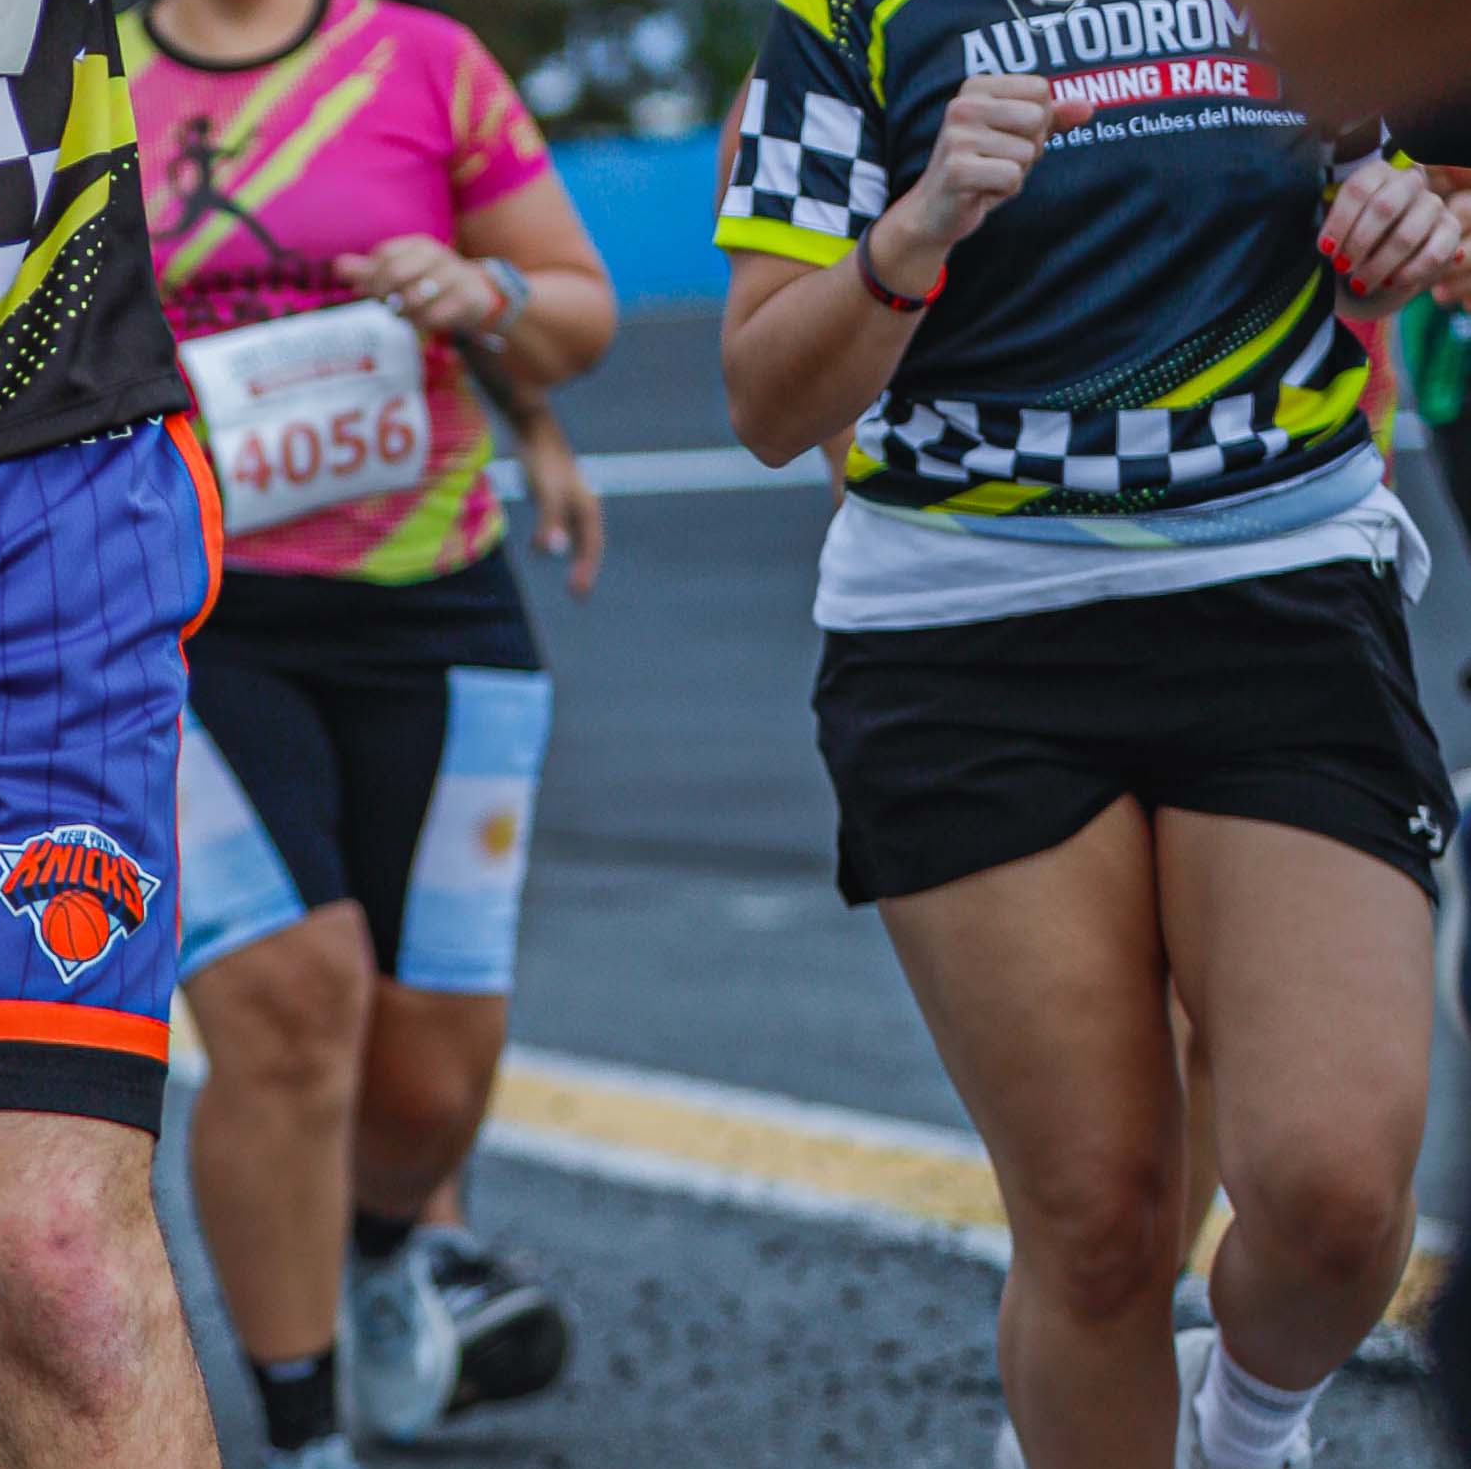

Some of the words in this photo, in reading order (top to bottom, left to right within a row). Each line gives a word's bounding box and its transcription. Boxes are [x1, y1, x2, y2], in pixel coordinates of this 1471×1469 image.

[1168, 59, 1249, 98] RACE
[1066, 126, 1095, 148] de
[1096, 120, 1127, 143] los
[1128, 111, 1197, 138] Clubes
[1197, 106, 1229, 129] del
[233, 396, 417, 492] 4056
[2, 838, 145, 924] KNICKS
